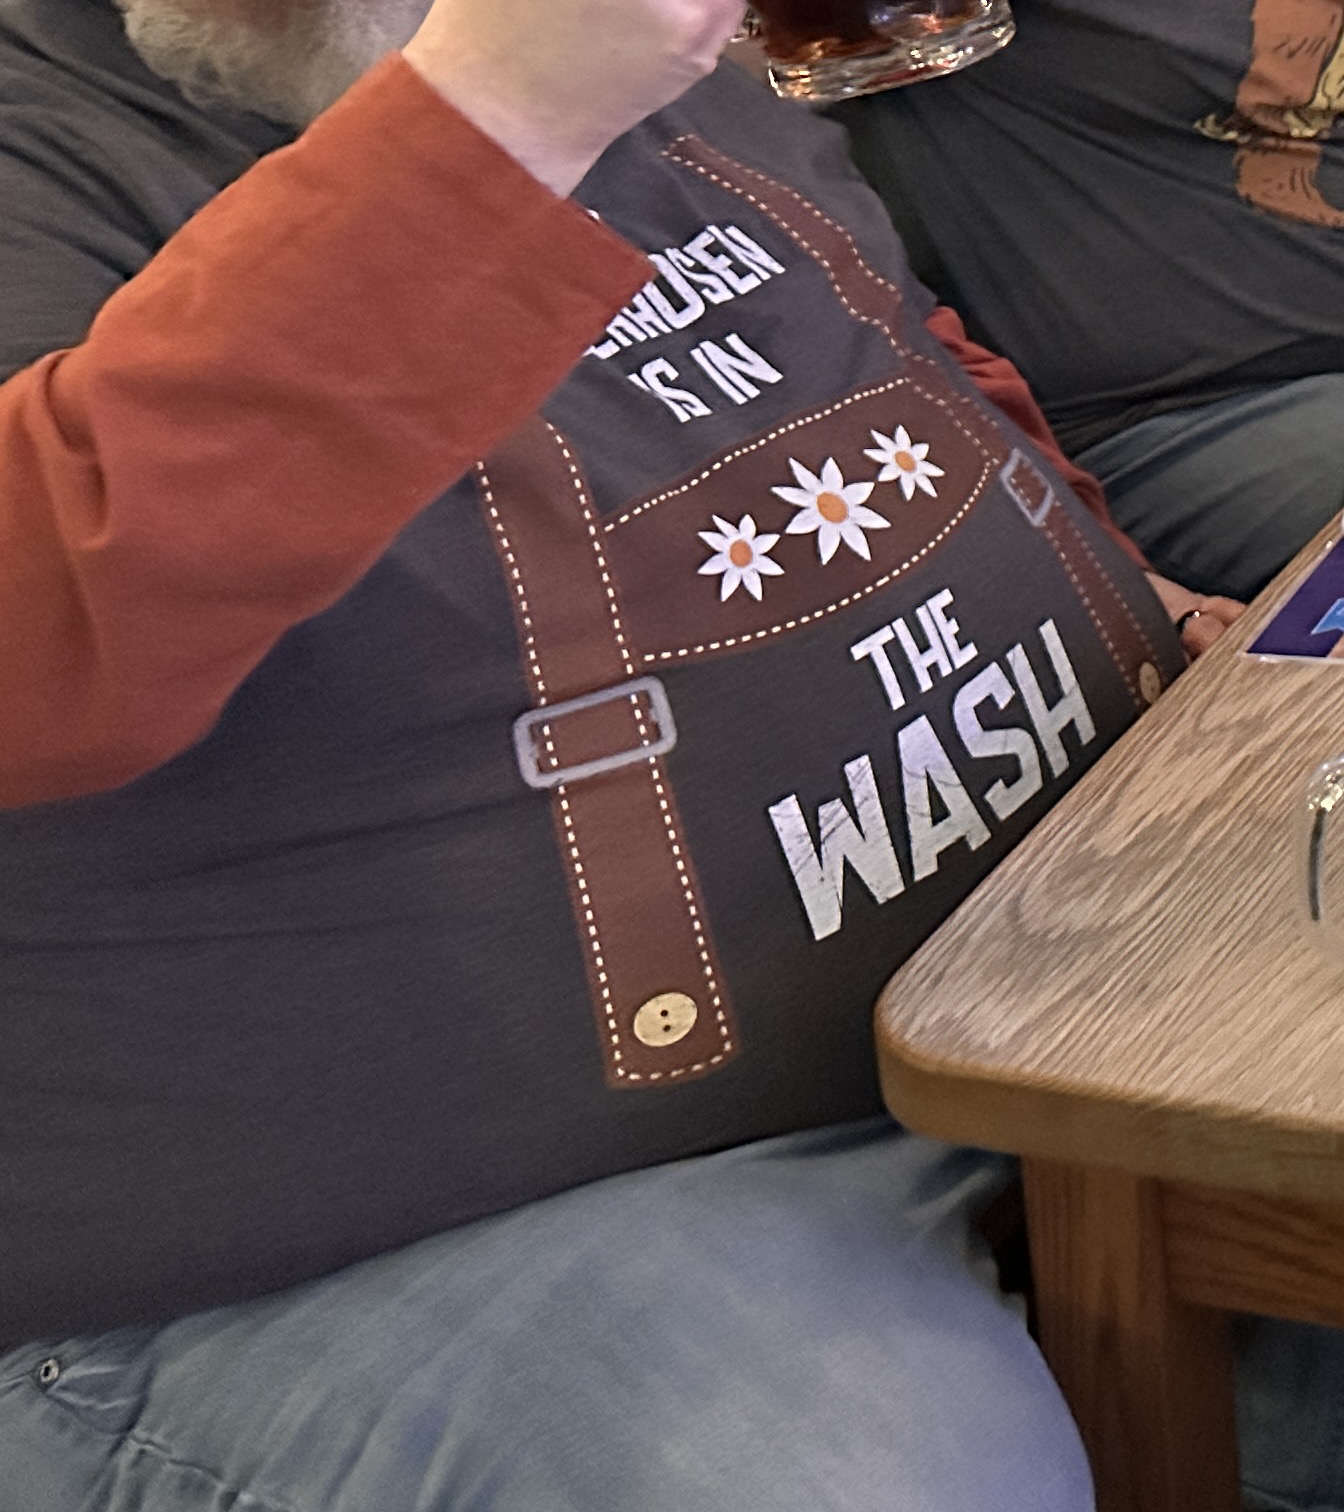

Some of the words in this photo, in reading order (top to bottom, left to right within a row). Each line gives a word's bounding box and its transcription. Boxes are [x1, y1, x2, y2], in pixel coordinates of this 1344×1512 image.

[626, 356, 714, 423] IS
[689, 332, 784, 406] IN
[850, 587, 978, 711] THE
[767, 618, 1098, 942] WASH
